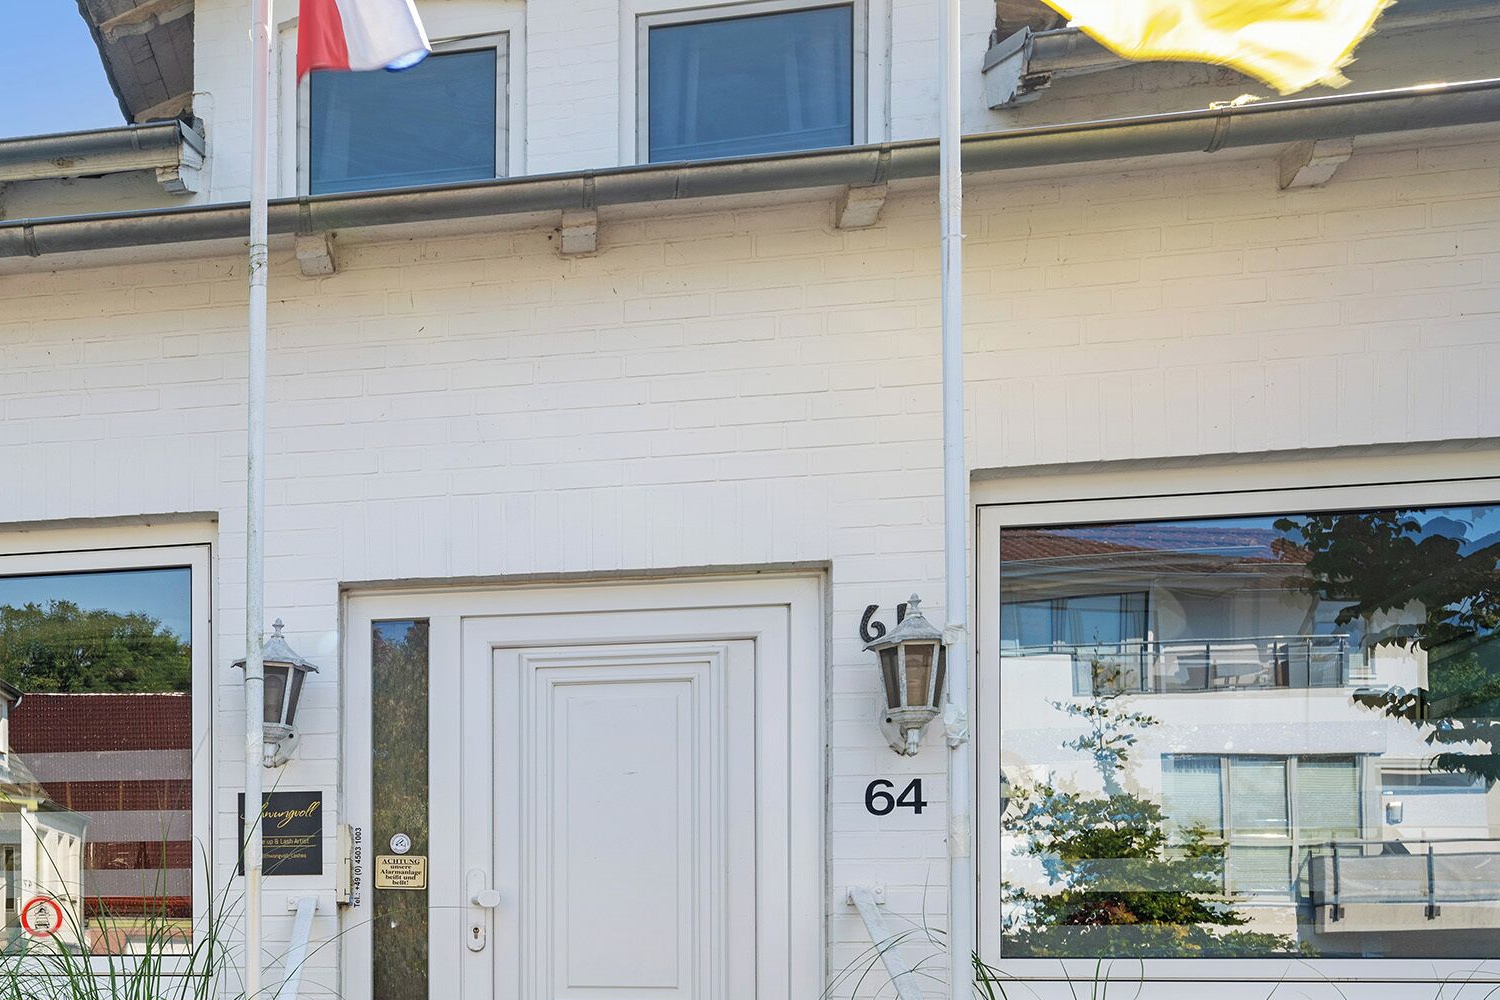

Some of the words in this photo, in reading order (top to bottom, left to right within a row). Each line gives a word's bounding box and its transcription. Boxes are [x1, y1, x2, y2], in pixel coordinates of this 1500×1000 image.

[865, 778, 927, 816] 64
[354, 827, 362, 844] 1003
[354, 865, 362, 875] (0)
